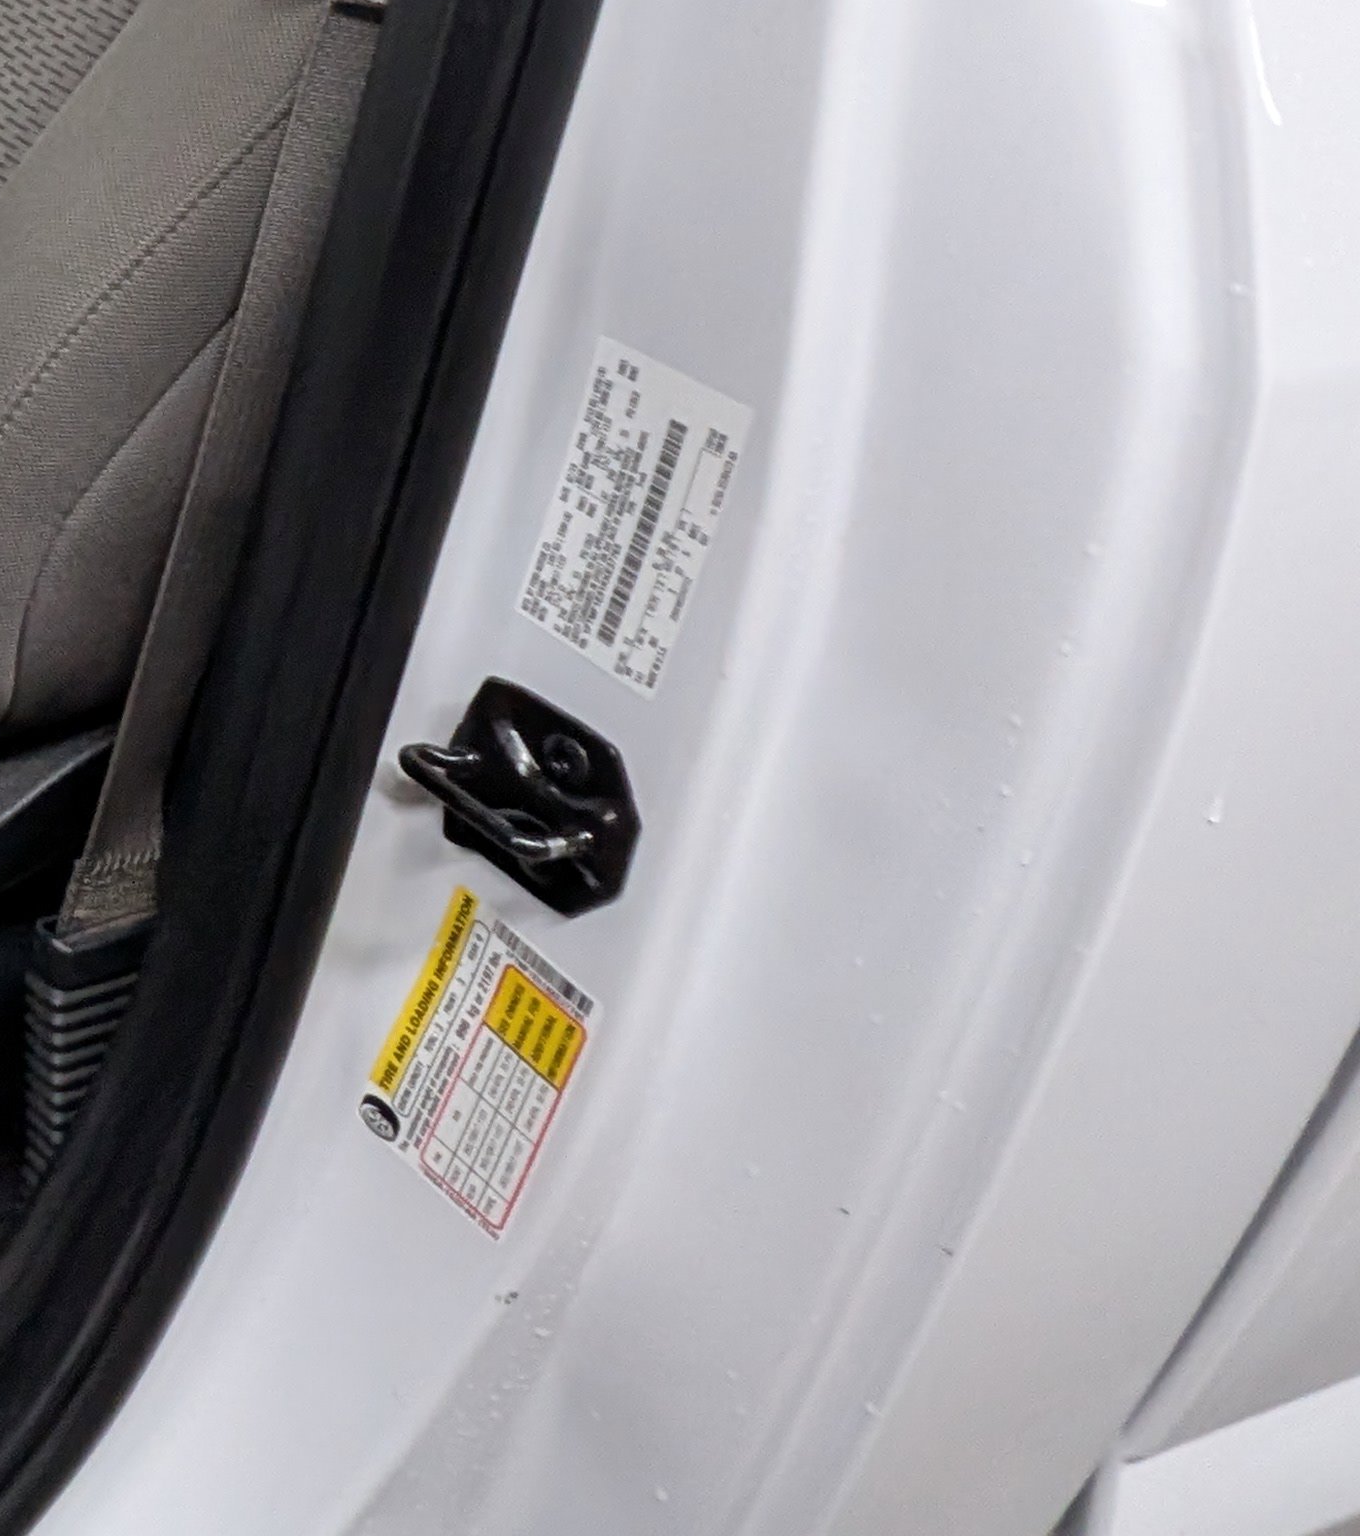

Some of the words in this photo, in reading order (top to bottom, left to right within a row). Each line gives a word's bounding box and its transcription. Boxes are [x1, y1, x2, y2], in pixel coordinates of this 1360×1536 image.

[379, 1061, 398, 1091] TIRE
[393, 1034, 411, 1063] AND
[406, 981, 439, 1035] LOADING
[434, 894, 474, 980] INFORMATION
